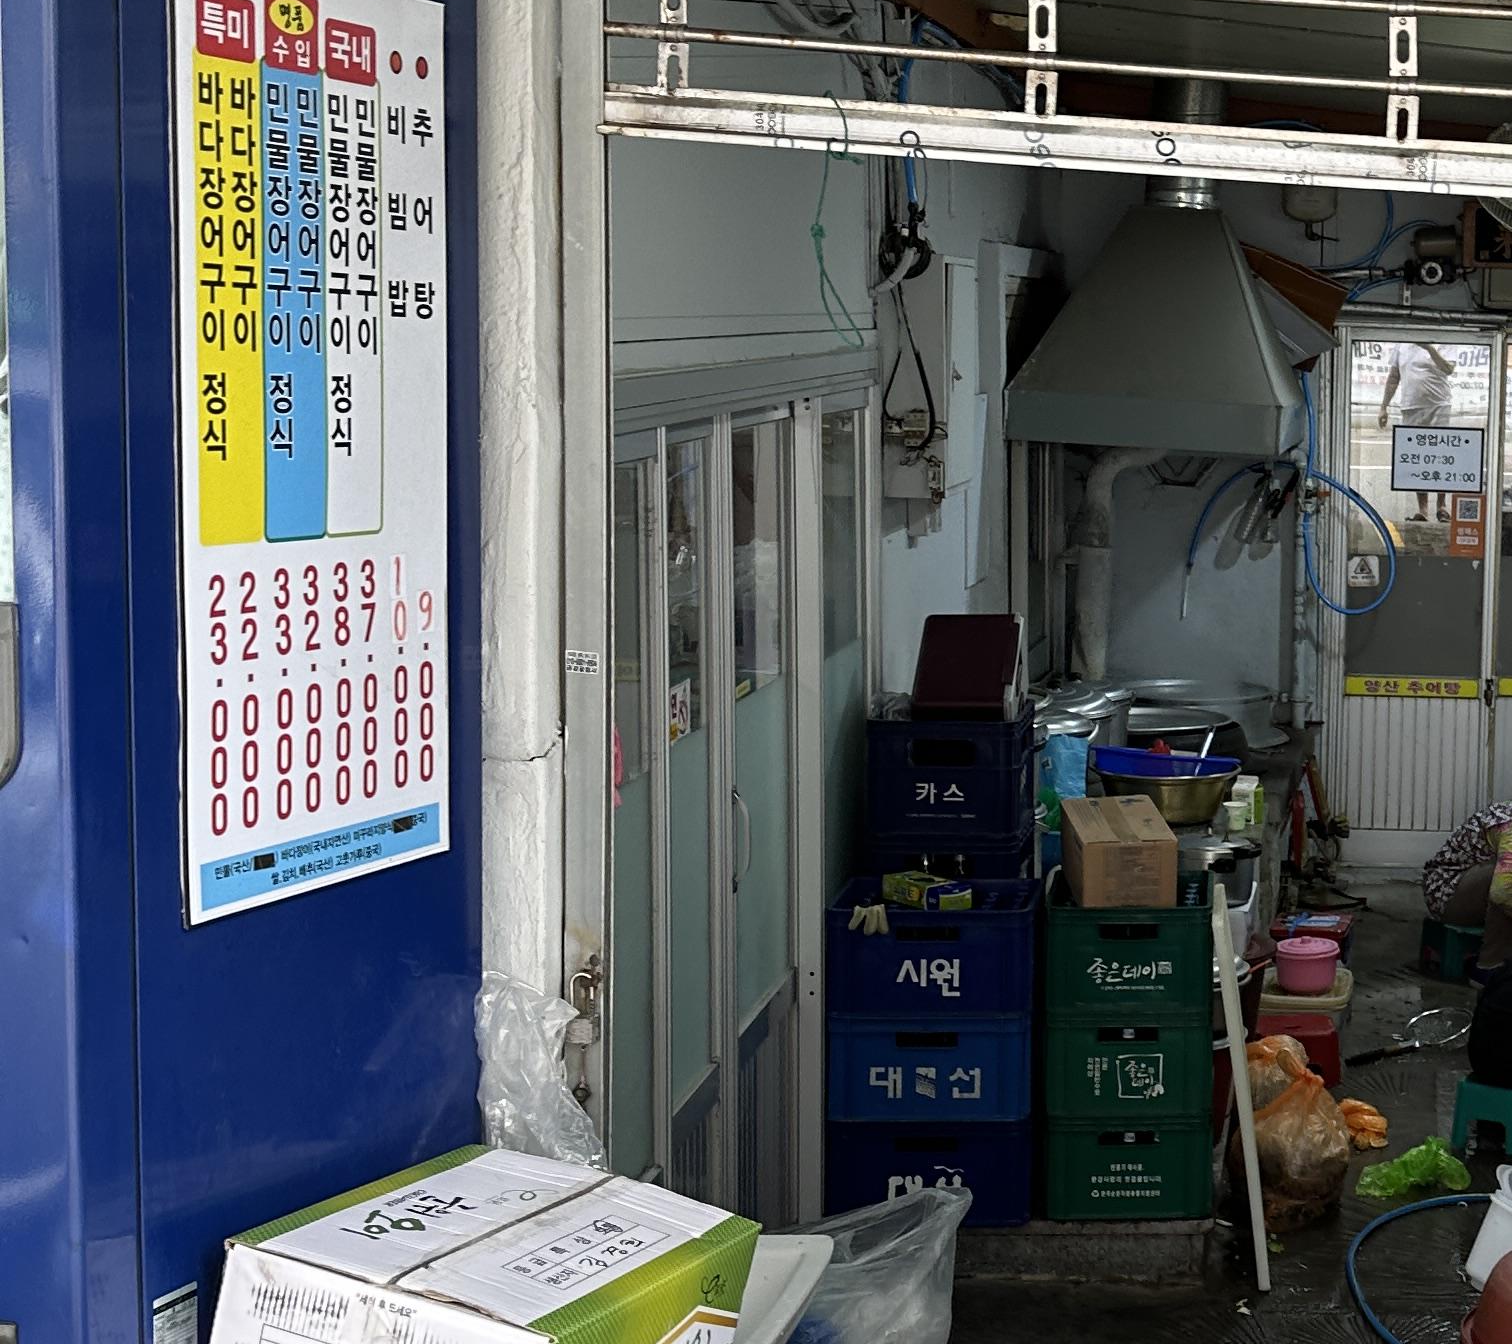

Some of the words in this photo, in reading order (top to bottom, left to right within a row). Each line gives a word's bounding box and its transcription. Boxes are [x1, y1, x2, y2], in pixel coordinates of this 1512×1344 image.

[200, 1, 250, 49] 특미
[278, 2, 305, 33] 명품
[272, 34, 312, 68] 수입
[328, 29, 373, 73] 국내
[197, 71, 227, 352] 바다장어구이
[230, 77, 258, 353] 바다장어구이
[266, 83, 292, 353] 민물장어구이
[296, 87, 322, 354] 민물장어구이
[327, 94, 353, 354] 민물장어구이
[355, 99, 379, 355] 민물장어구이
[387, 105, 409, 318] 비빔밥
[412, 108, 435, 320] 추어탕
[202, 372, 227, 461] 정식
[269, 372, 293, 459] 정식
[331, 373, 352, 457] 정식
[1415, 433, 1462, 448] 영업시간
[1399, 453, 1421, 465] 오전
[1423, 454, 1455, 465] 07:30
[1444, 472, 1476, 483] 21:00
[1364, 679, 1401, 693] 양산
[1407, 680, 1462, 696] 추어탕
[915, 782, 966, 805] 카스
[896, 958, 961, 997] 시원
[1086, 957, 1157, 984] 좋은데이
